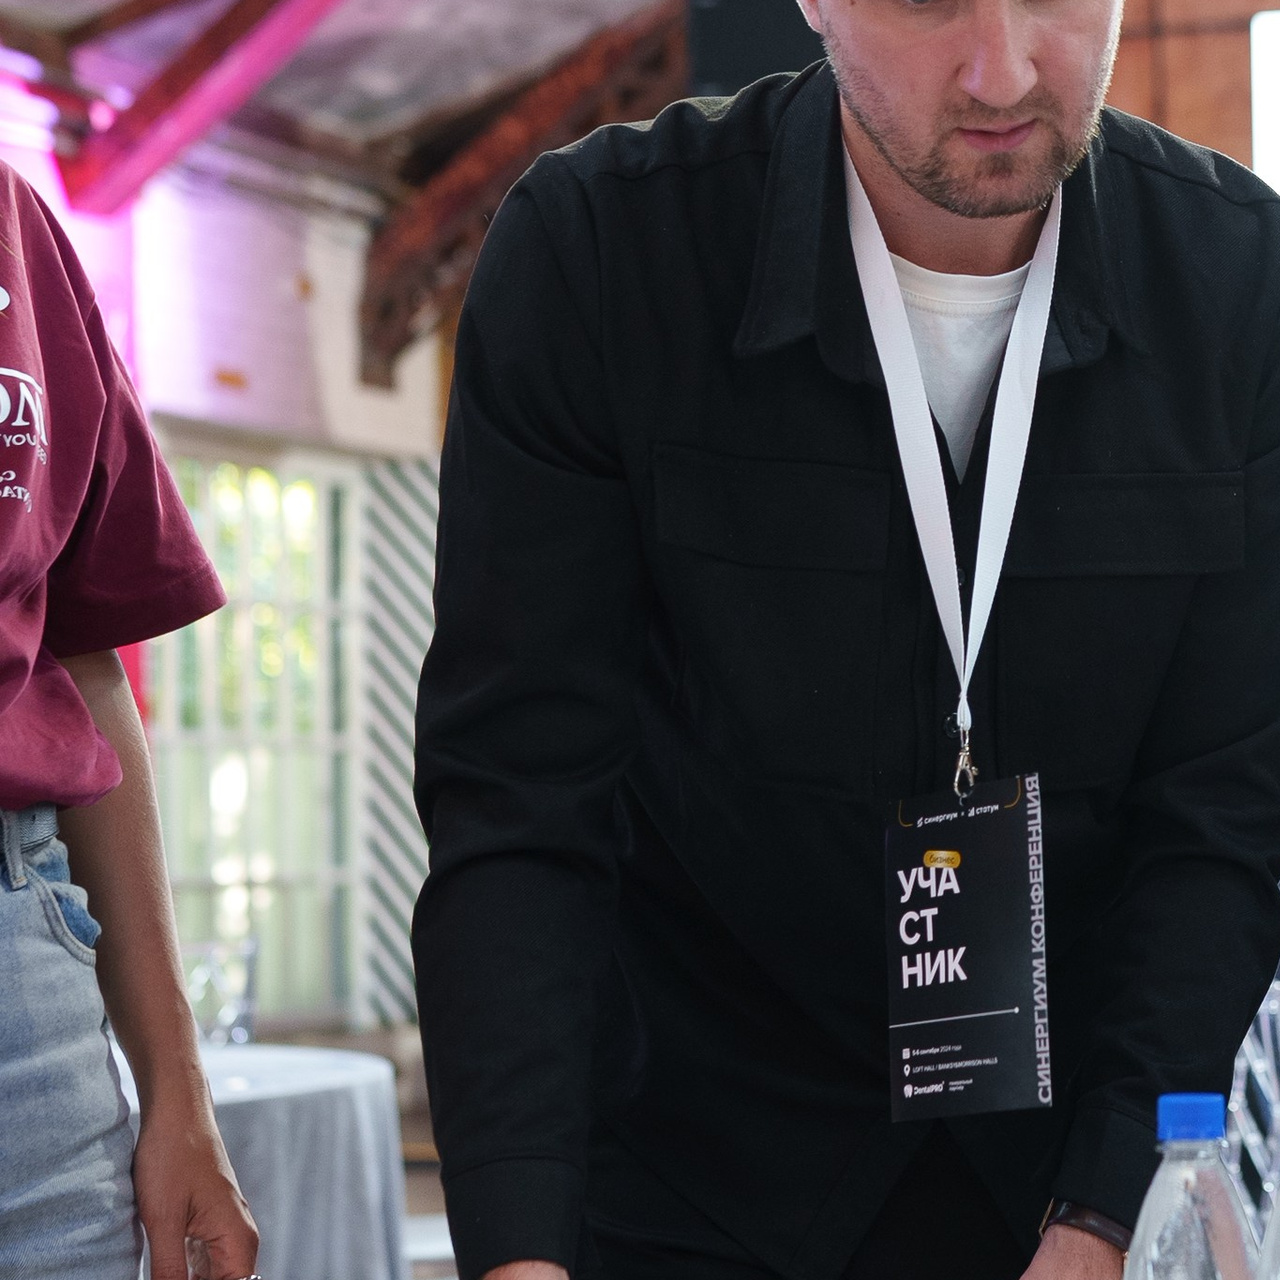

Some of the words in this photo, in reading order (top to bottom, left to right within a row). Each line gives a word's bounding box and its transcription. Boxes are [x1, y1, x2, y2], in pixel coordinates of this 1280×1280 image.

[1024, 773, 1047, 952] КОНФЕРЕНЦИЯ
[897, 866, 960, 903] УЧА
[899, 907, 938, 945] СТ
[902, 946, 967, 989] НИК
[1032, 959, 1052, 1105] СИНЕРГИУМ
